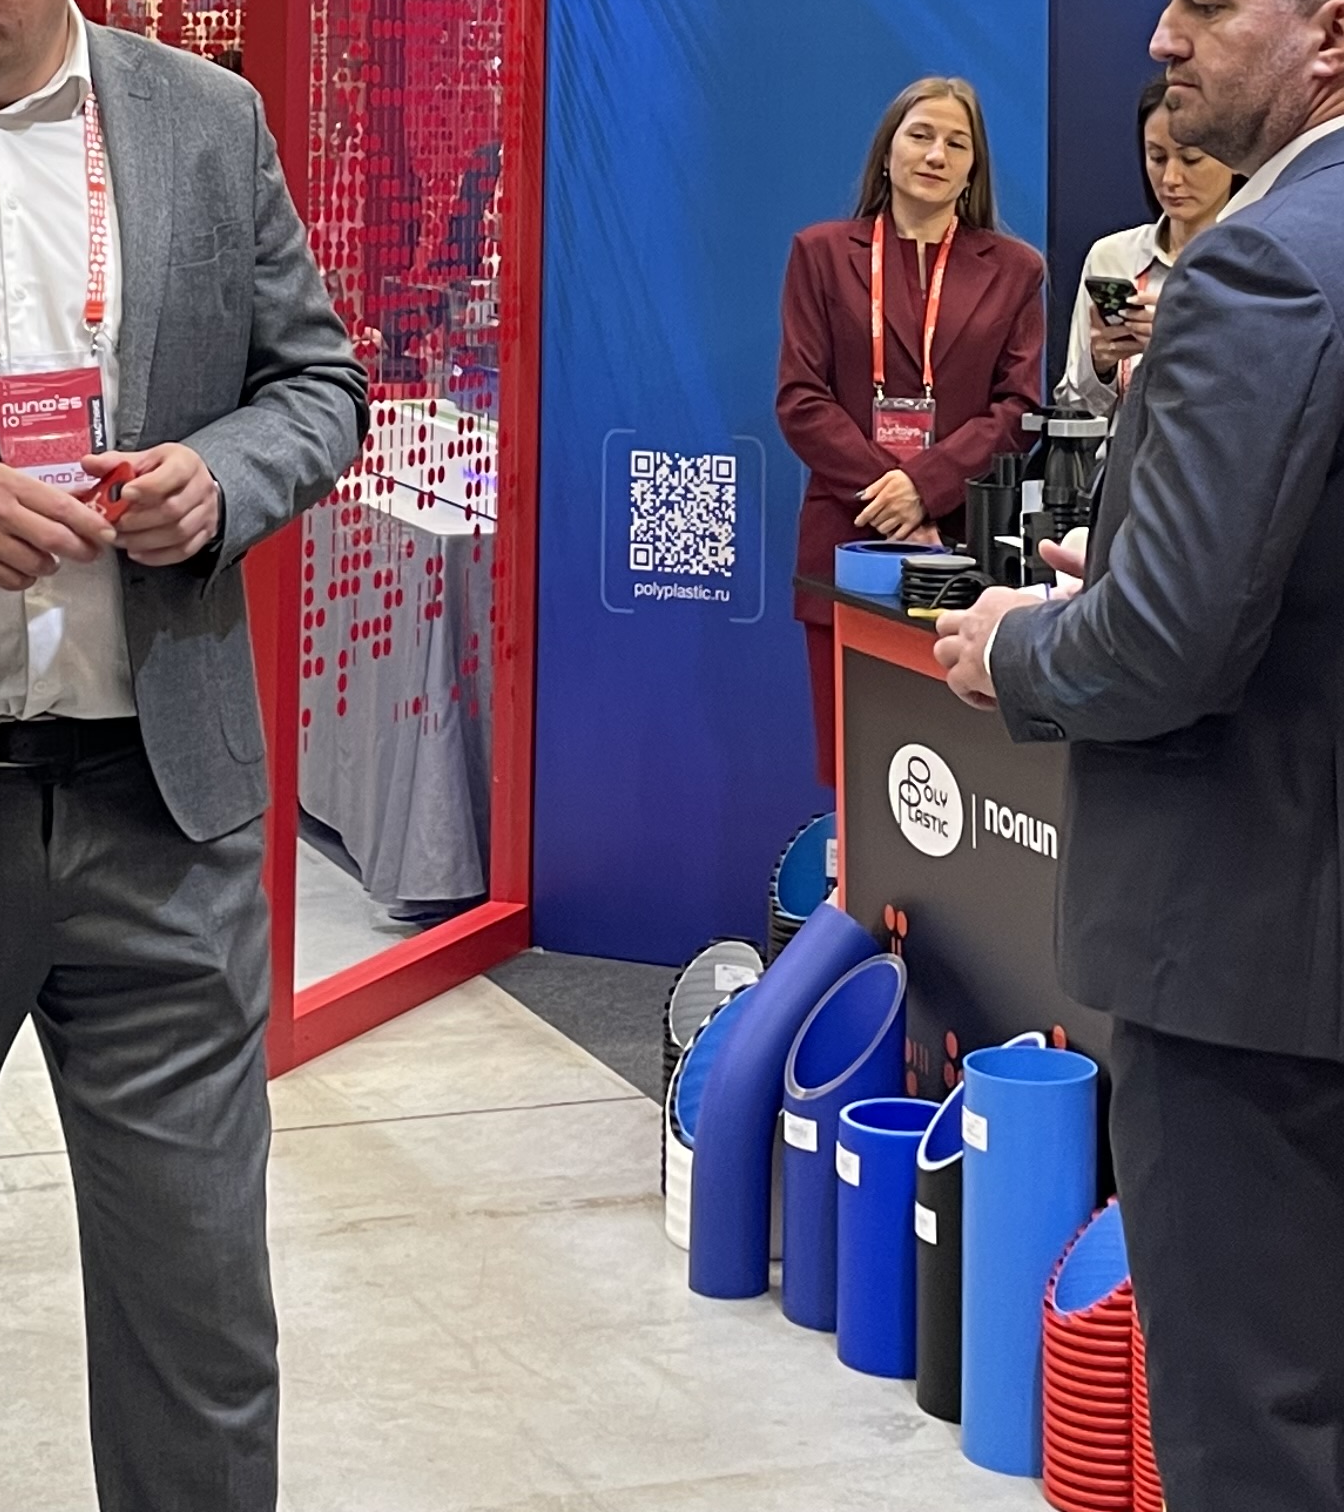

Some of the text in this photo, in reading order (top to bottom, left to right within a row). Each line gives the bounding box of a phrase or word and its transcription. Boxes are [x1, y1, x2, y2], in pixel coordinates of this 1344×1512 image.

[634, 581, 730, 602] polyplastic.ru
[908, 755, 949, 808] POLY
[899, 779, 949, 838] PLASTIC
